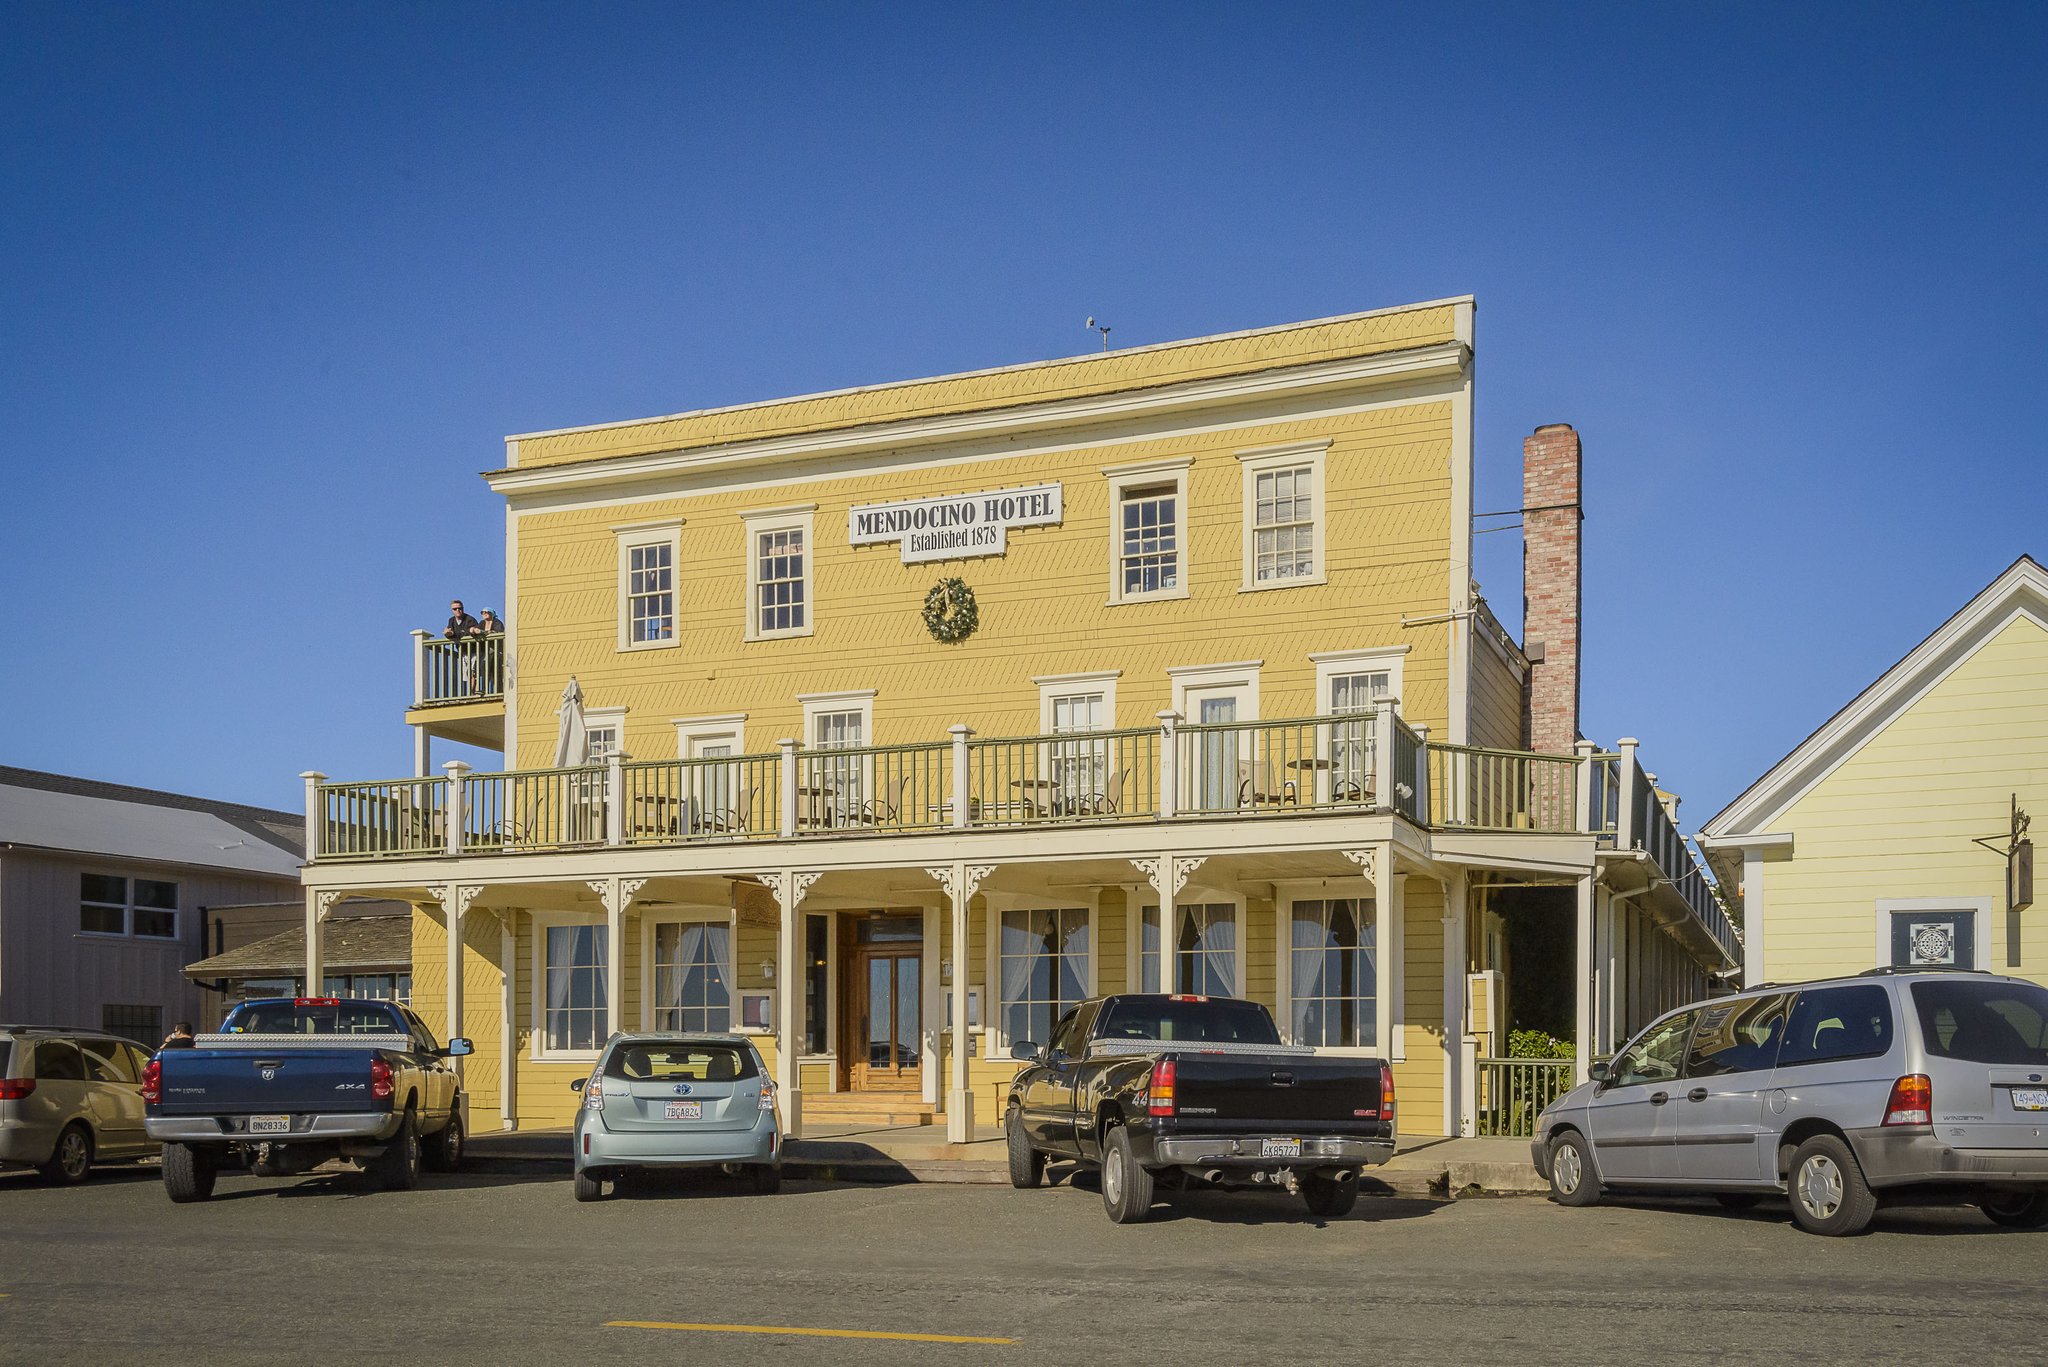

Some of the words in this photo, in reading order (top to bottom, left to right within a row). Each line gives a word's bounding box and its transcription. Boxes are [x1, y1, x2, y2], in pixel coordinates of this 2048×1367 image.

[857, 501, 976, 536] MENDOCINO
[984, 492, 1054, 522] HOTEL
[910, 529, 968, 553] Established
[971, 525, 997, 546] 1878
[666, 1107, 699, 1118] 7BGA824
[252, 1121, 288, 1131] 8N28336
[1263, 1145, 1299, 1157] 6K85727
